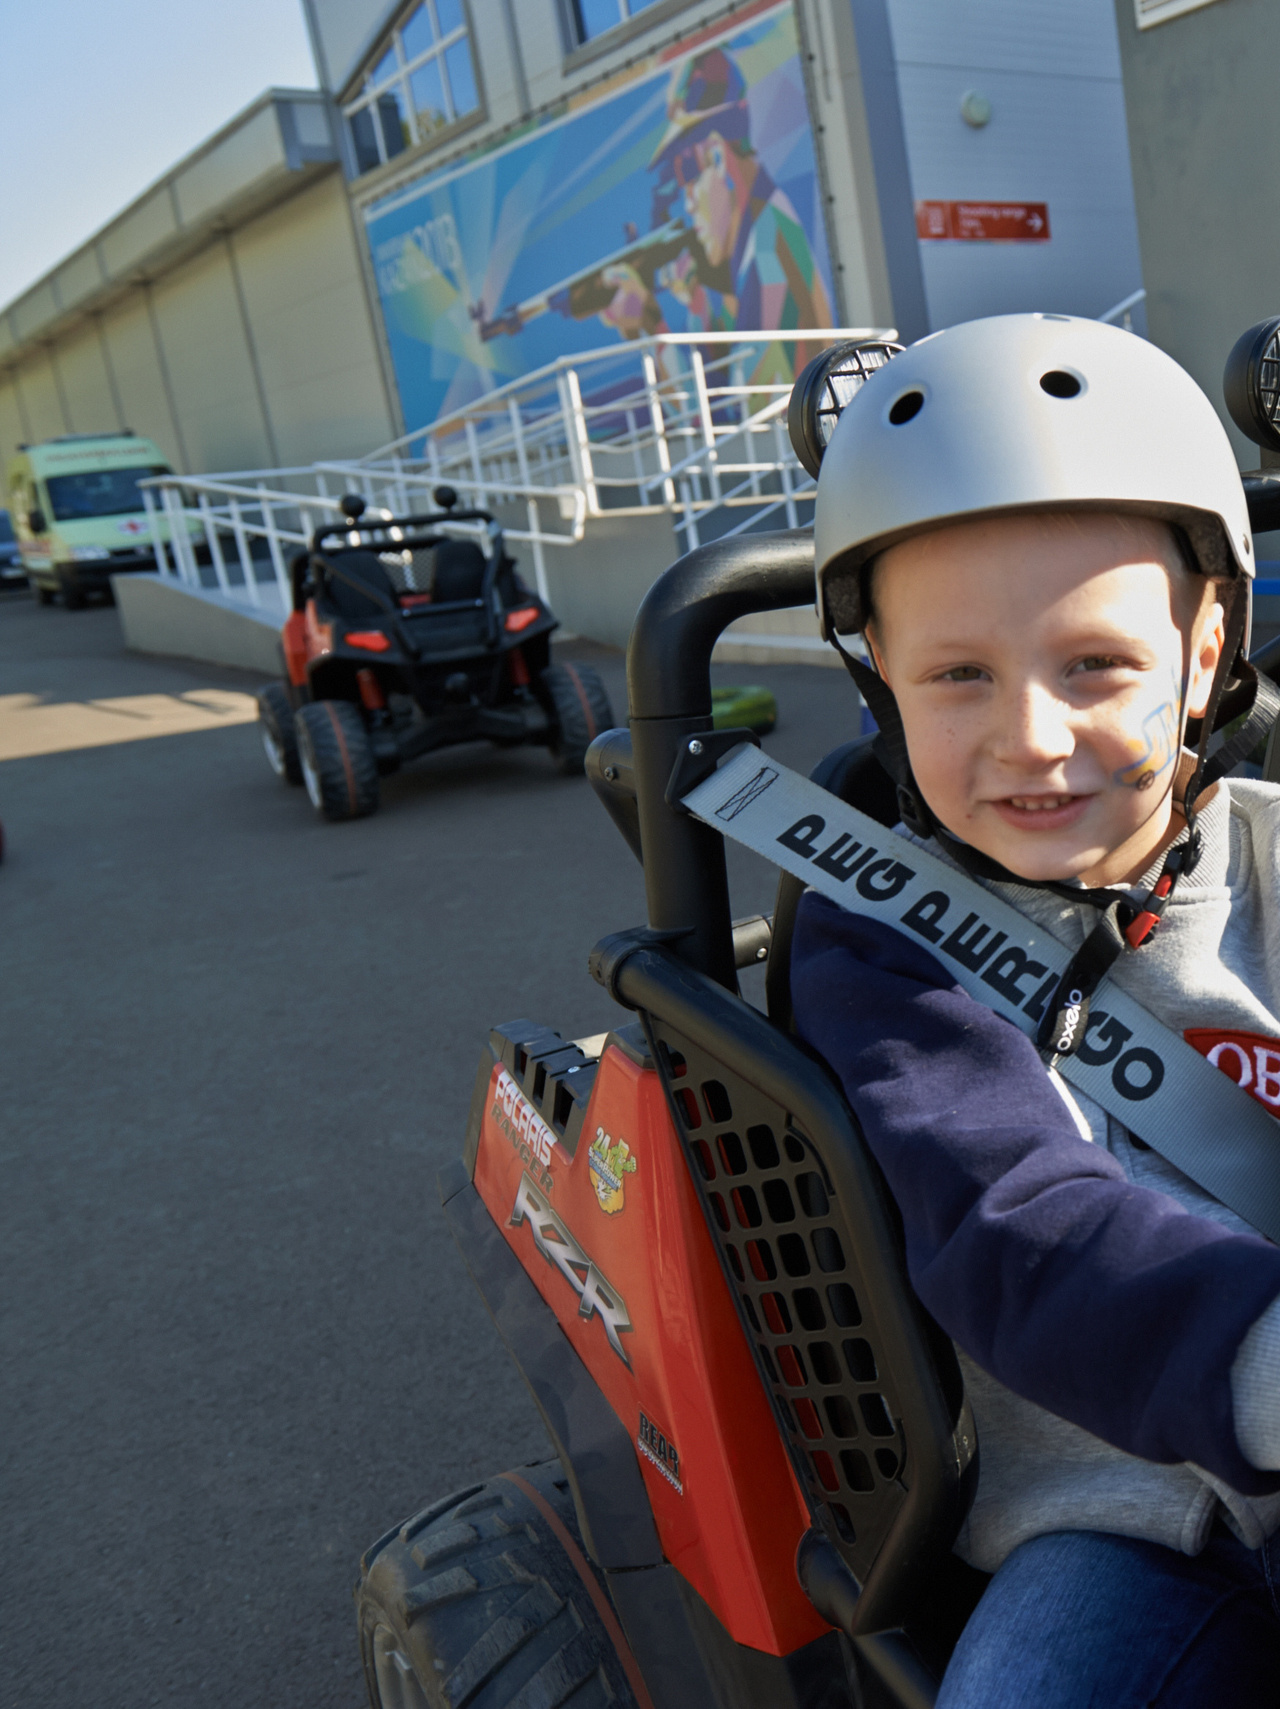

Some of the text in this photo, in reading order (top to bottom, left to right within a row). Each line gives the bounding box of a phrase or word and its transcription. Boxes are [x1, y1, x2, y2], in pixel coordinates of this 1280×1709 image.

[776, 813, 917, 902] PEG
[1056, 988, 1083, 1051] oxelo
[488, 1102, 555, 1194] RANGER
[495, 1069, 558, 1168] POLARIS
[510, 1169, 635, 1375] RZR
[639, 1410, 680, 1477] REAR
